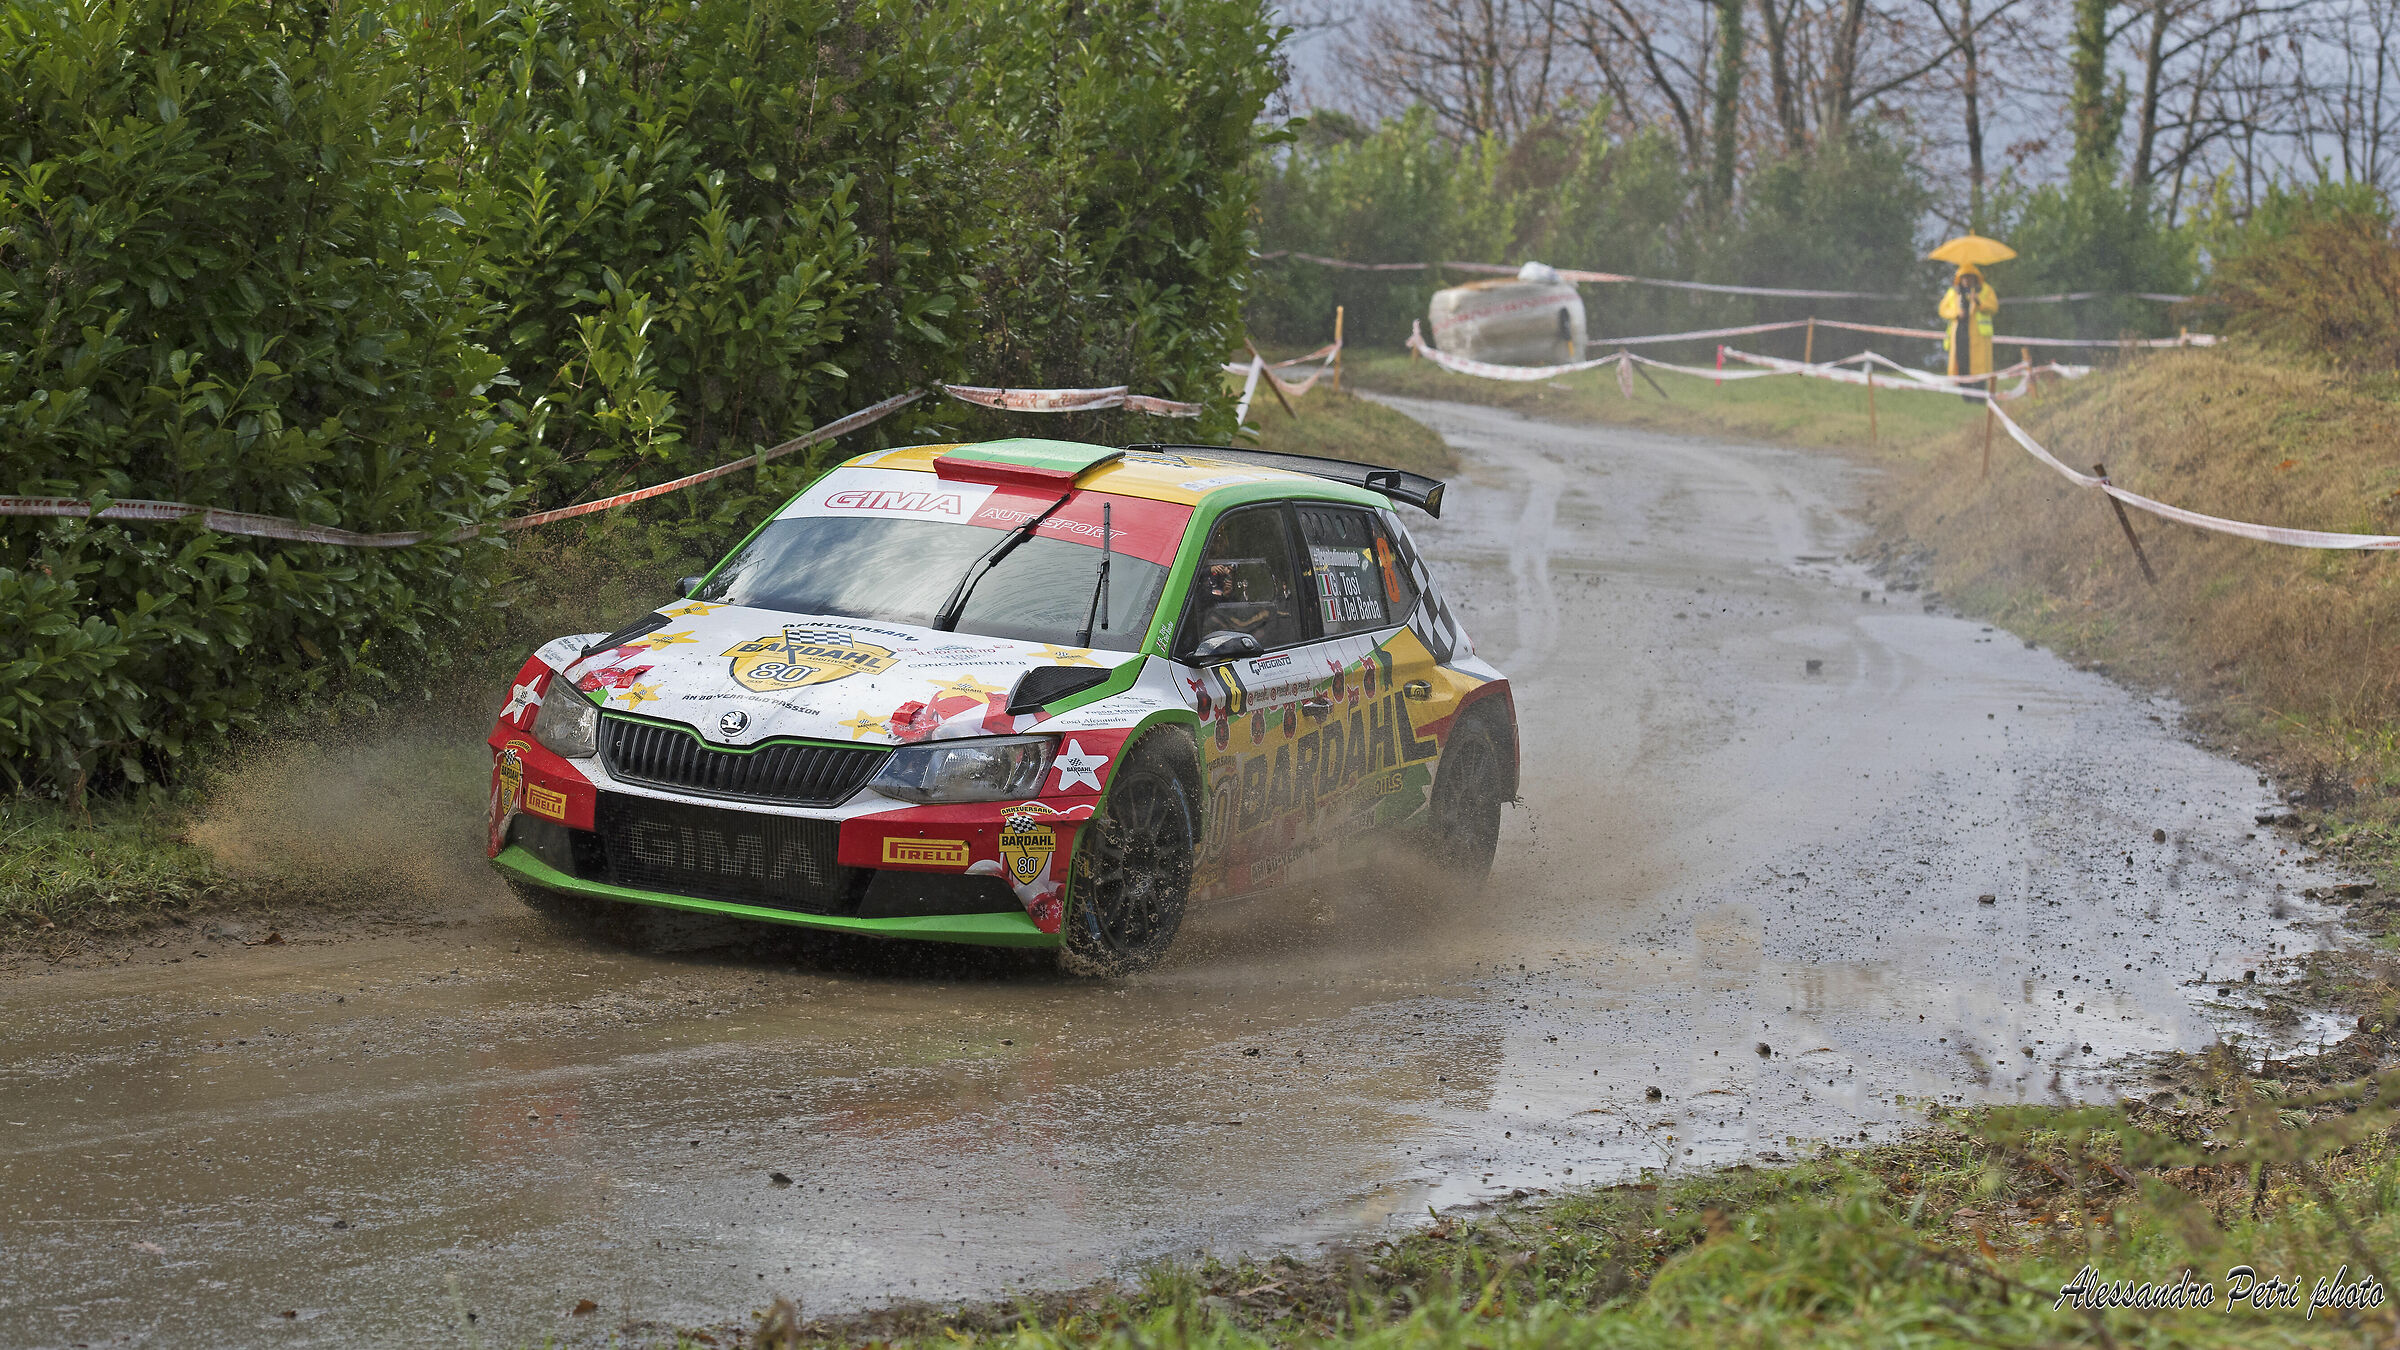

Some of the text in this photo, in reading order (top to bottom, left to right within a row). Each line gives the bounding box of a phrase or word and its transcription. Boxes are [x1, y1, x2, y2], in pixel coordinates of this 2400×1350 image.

[824, 490, 962, 515] GIMA
[978, 507, 1128, 540] AUTSPORT
[1376, 537, 1400, 603] 8
[1329, 572, 1341, 596] G.
[1340, 571, 1361, 596] Tosi
[1335, 595, 1381, 621] A. Del Barba
[783, 622, 919, 641] ANNIVERSARY
[733, 642, 881, 669] BARDAHL
[1219, 665, 1242, 713] 8
[771, 699, 821, 716] PASSION
[1238, 689, 1438, 836] BARDAHL
[1375, 773, 1403, 796] OILS
[529, 788, 563, 814] PIRELLI
[1001, 806, 1053, 815] ANNIVERSARY
[889, 841, 963, 861] PIRELLI
[1001, 835, 1054, 847] BARDAHL
[630, 821, 824, 887] GIMA
